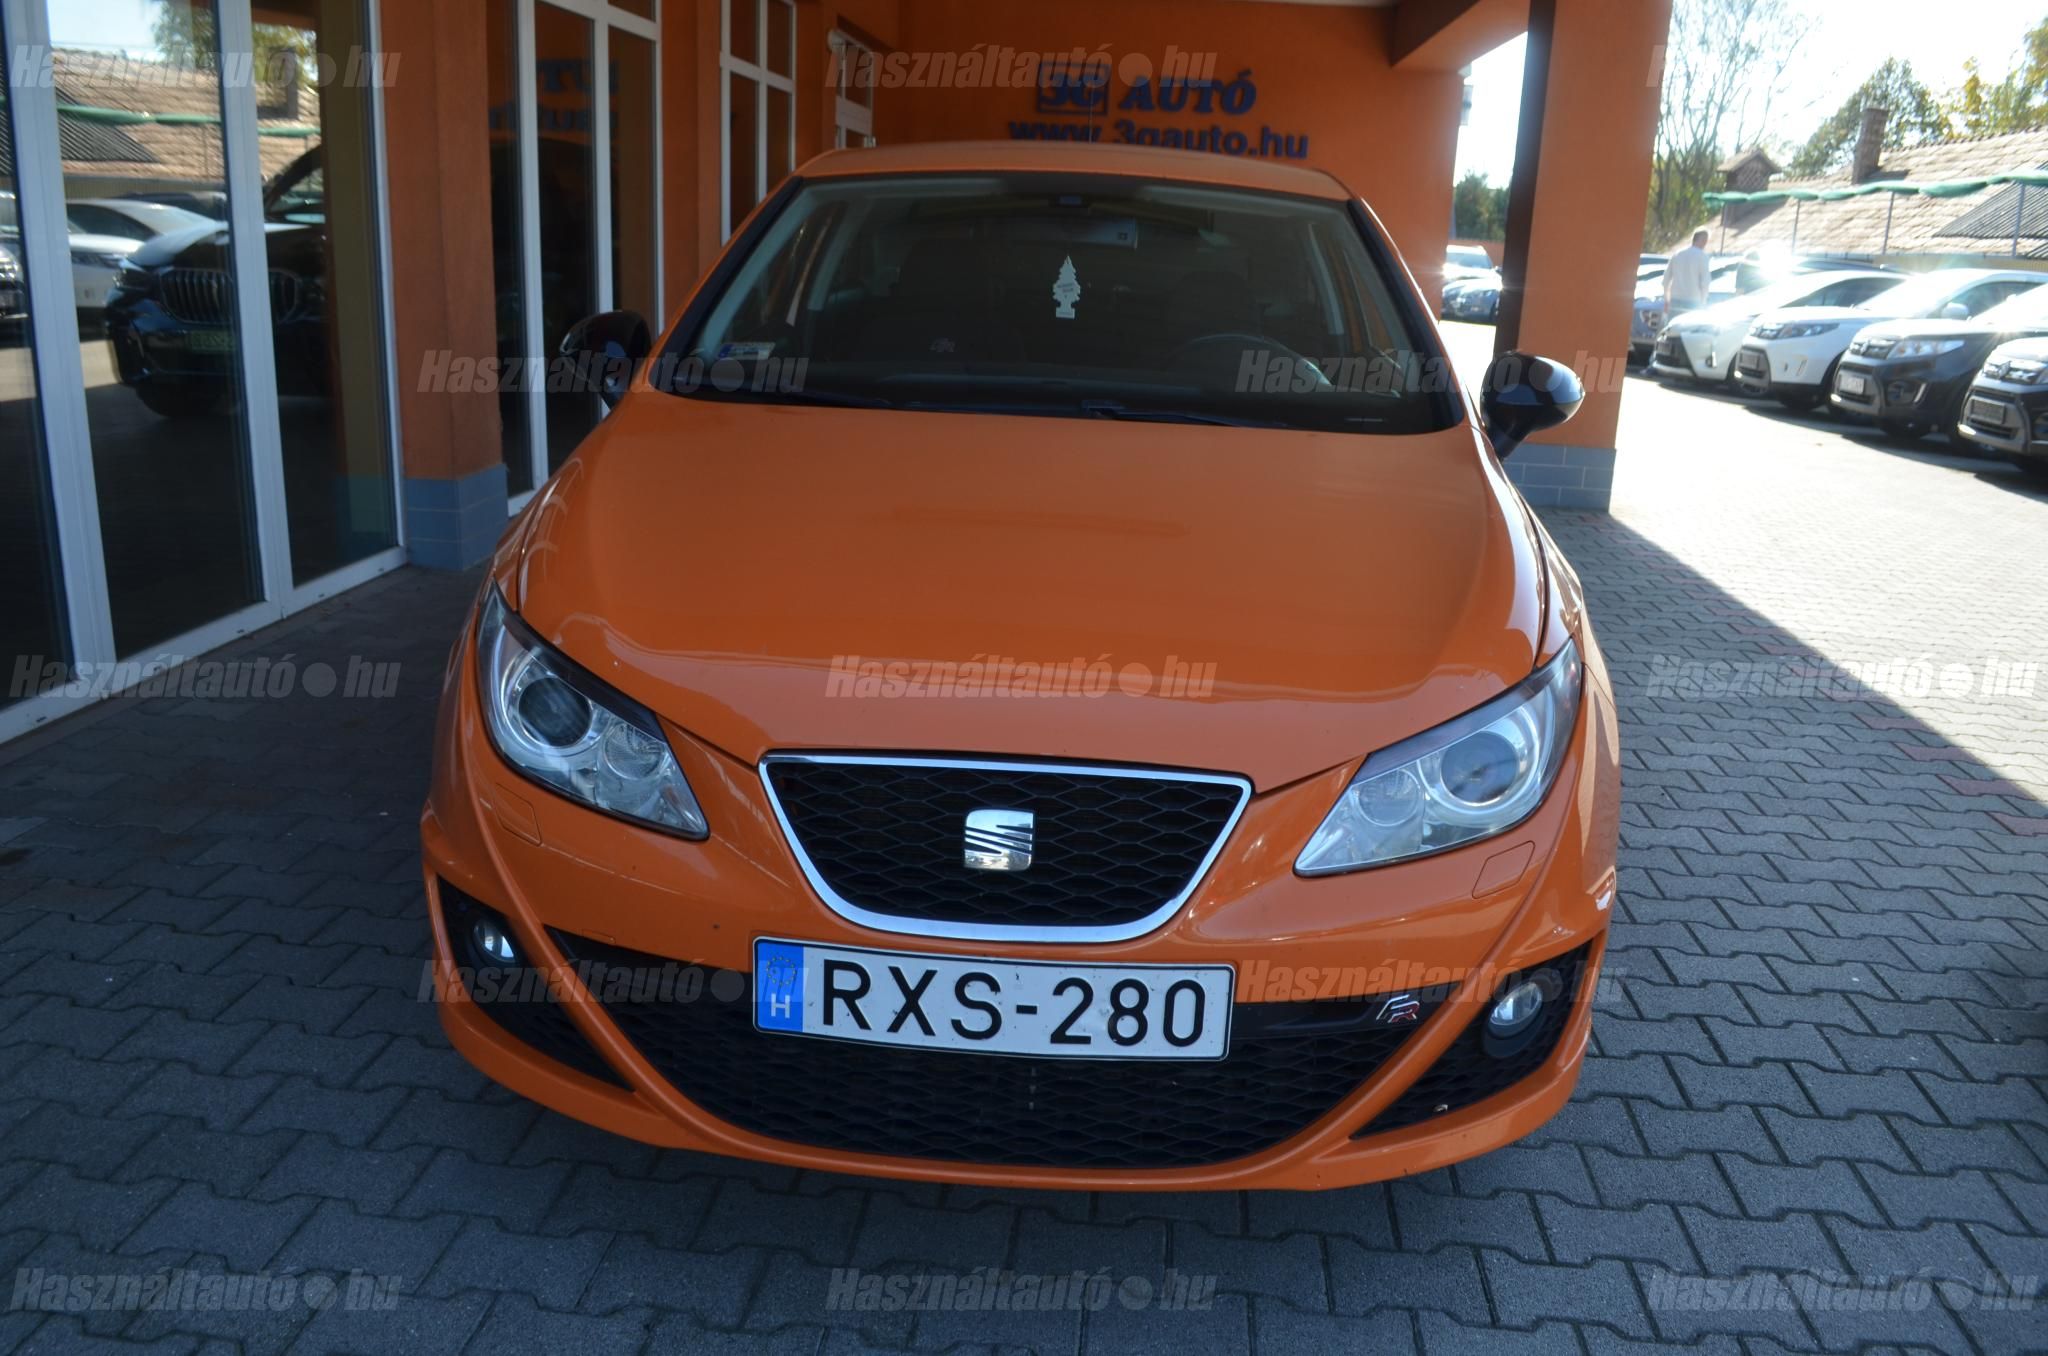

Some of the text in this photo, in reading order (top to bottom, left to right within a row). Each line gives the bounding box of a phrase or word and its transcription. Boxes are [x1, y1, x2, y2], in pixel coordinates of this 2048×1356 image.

[1119, 69, 1258, 115] AUTÓ
[1008, 118, 1309, 159] www3gauto.hu
[822, 958, 1206, 1048] RXS-280
